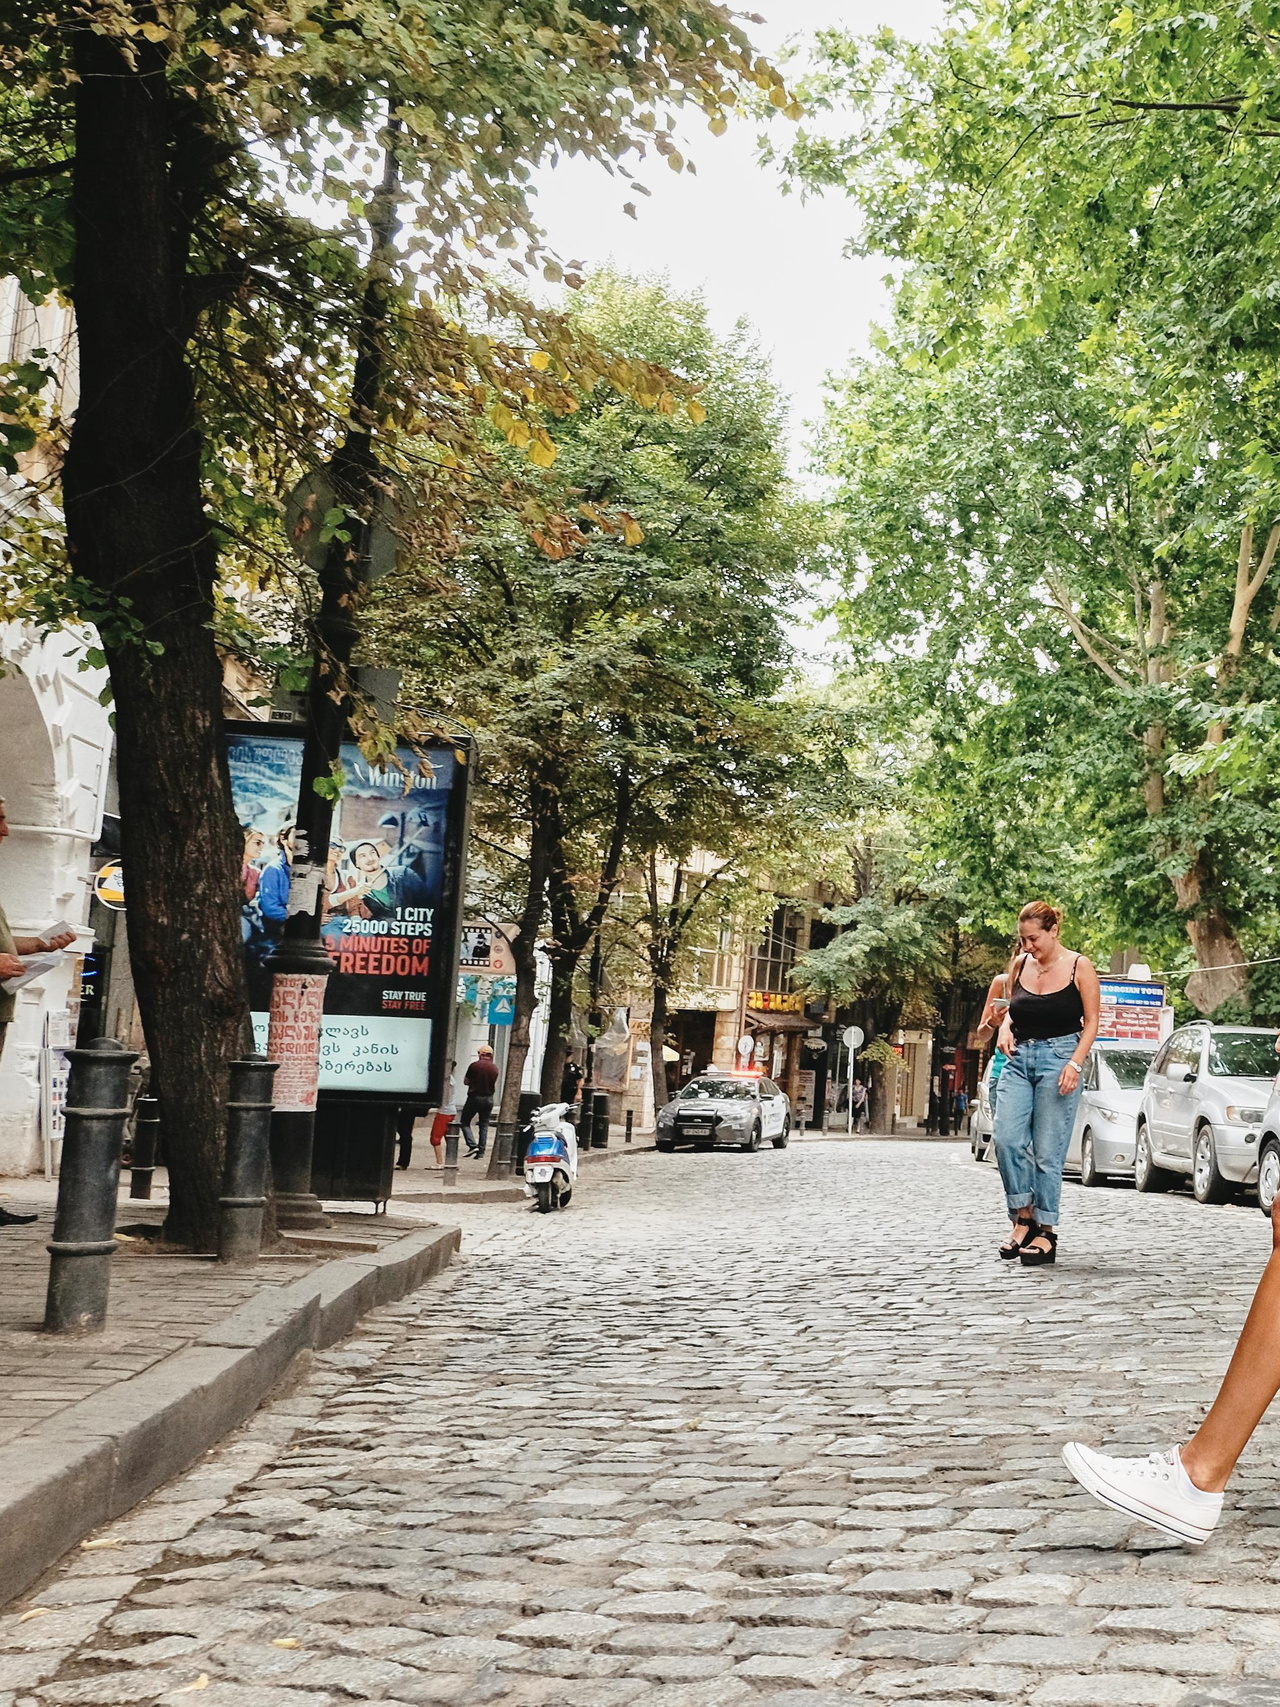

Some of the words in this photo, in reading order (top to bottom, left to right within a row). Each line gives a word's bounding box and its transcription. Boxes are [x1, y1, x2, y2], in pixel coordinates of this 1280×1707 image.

[396, 907, 402, 920] 1
[405, 907, 434, 921] CITY
[342, 919, 388, 934] 25000
[391, 922, 432, 936] STEPS
[340, 936, 409, 954] MINUTES
[412, 939, 431, 954] OF
[382, 990, 404, 1000] STAY
[405, 992, 427, 1001] TRUE
[382, 1000, 402, 1009] STAY
[404, 1001, 425, 1010] FREE
